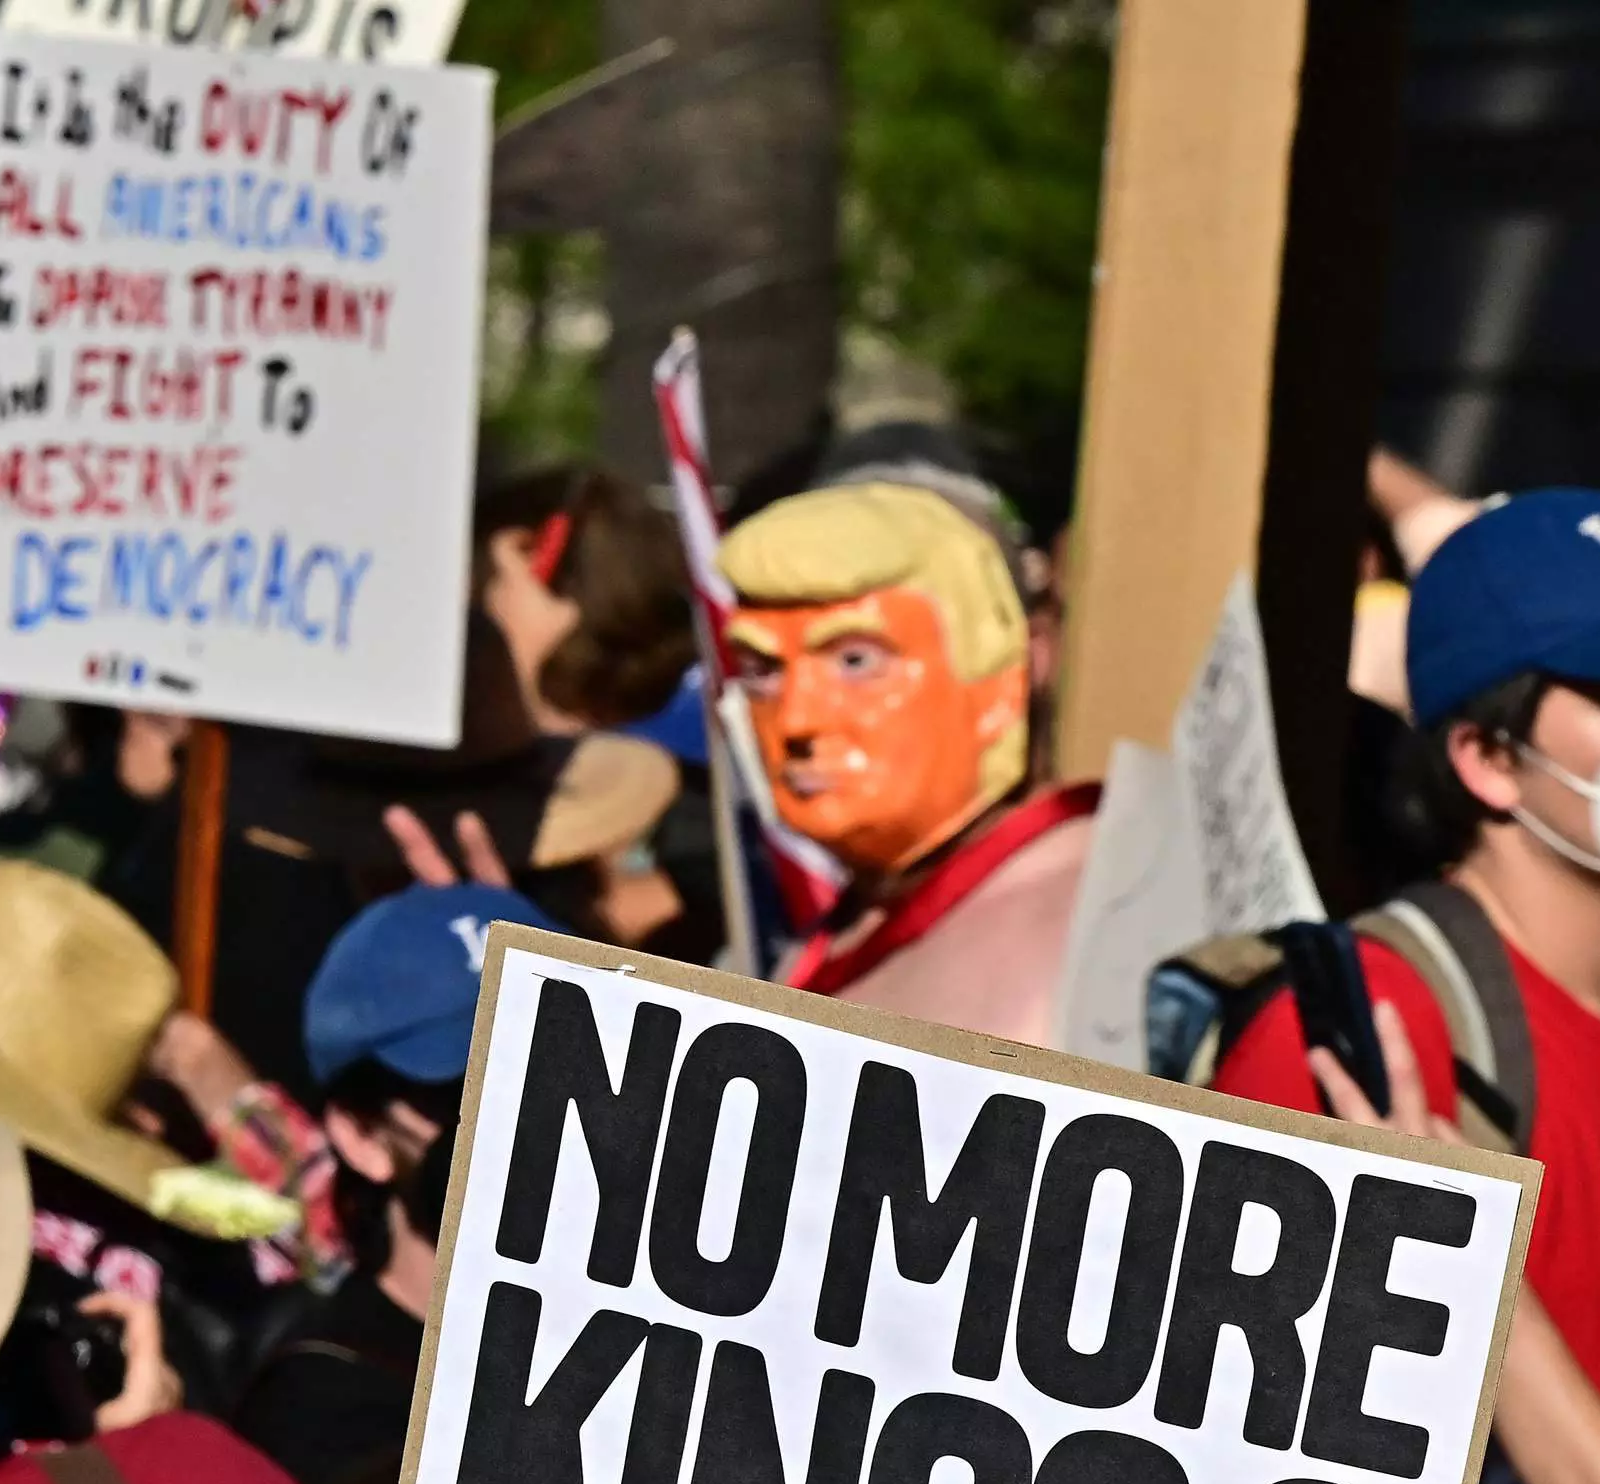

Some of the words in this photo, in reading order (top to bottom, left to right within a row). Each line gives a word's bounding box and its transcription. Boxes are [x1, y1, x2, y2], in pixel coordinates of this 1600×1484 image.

[198, 78, 352, 178] DUTY
[102, 172, 388, 262] AMERICANS
[30, 264, 172, 334] OPPOSE
[188, 264, 396, 352] TYRANNY
[68, 342, 246, 422] FIGHT
[10, 527, 372, 652] DEMOCRACY
[496, 978, 807, 1316] NO
[814, 1061, 1476, 1479] MORE
